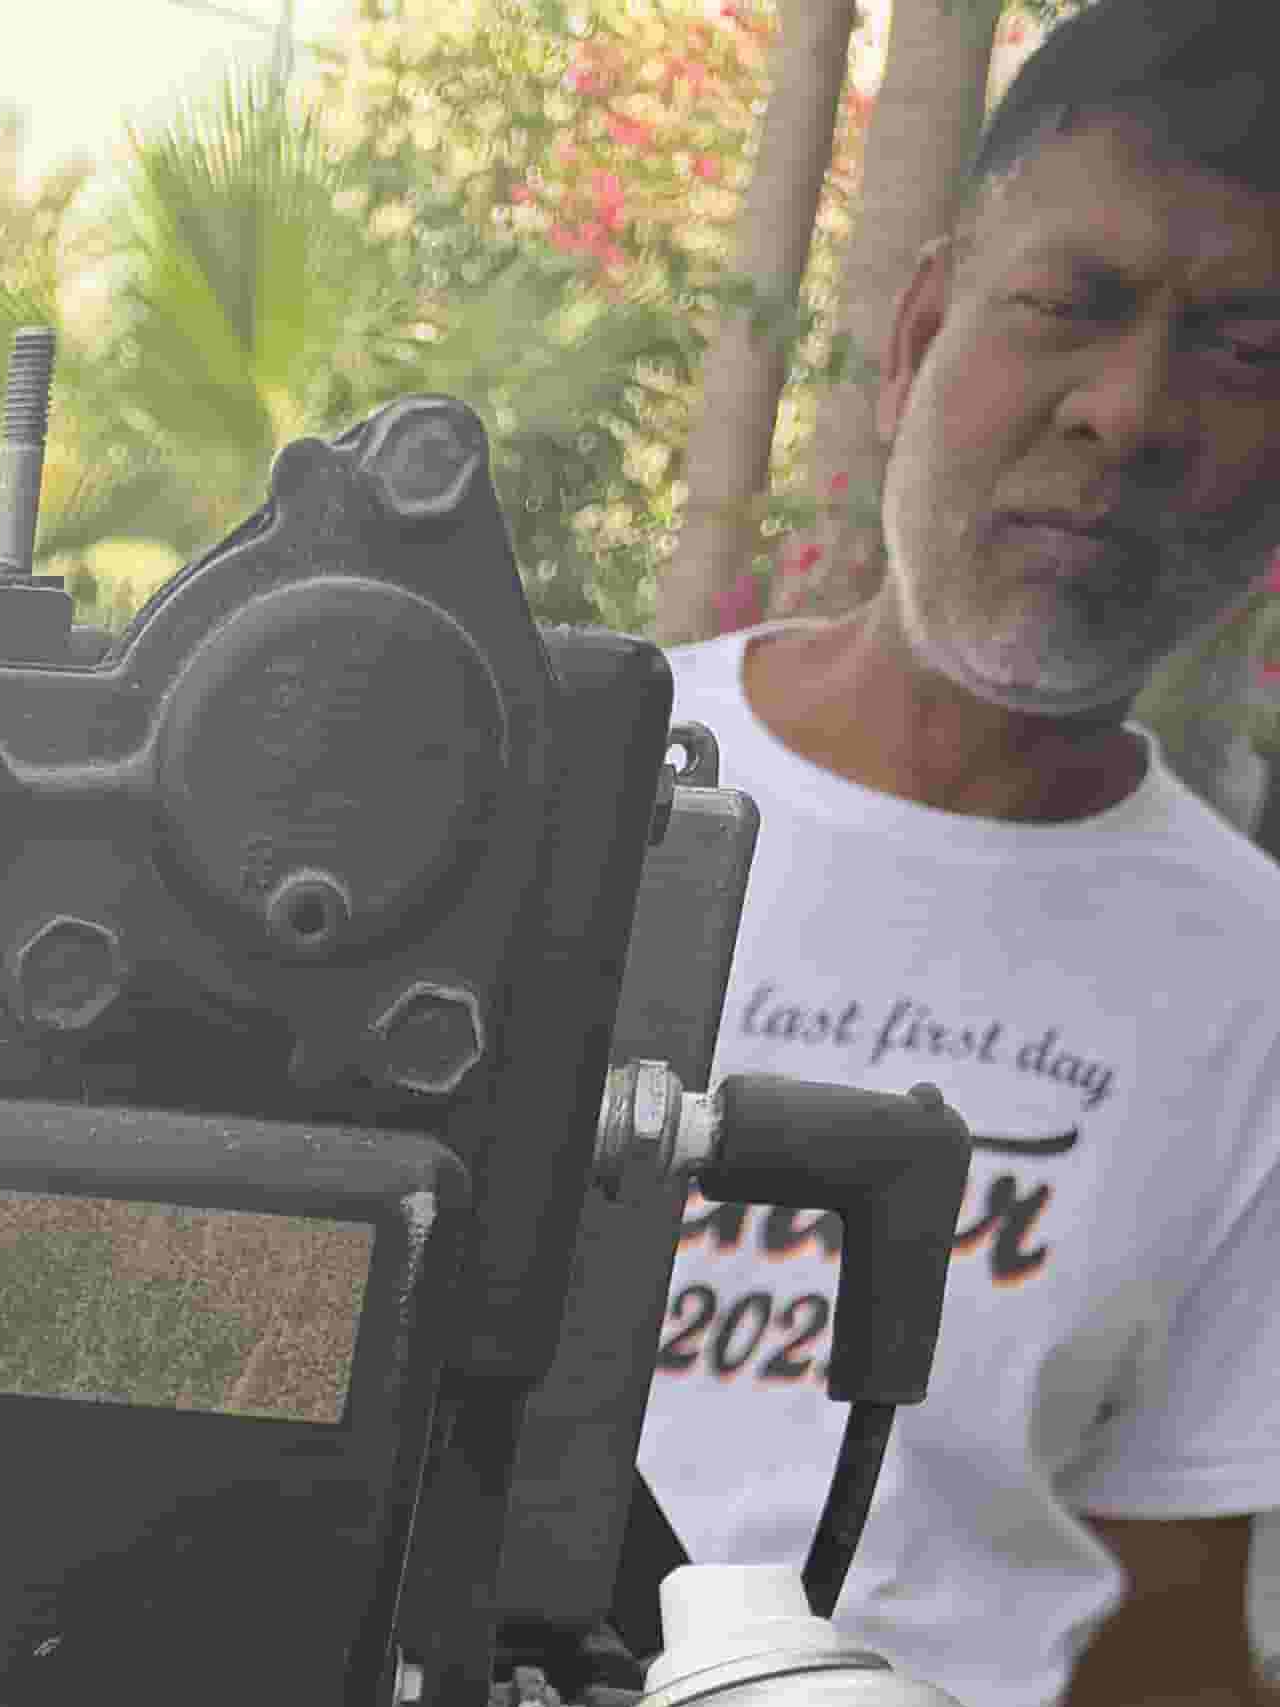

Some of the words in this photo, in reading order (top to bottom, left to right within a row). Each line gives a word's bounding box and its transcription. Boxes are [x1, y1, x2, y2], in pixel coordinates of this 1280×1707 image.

[744, 982, 863, 1040] last
[870, 997, 1005, 1067] first
[1015, 1028, 1115, 1110] day
[655, 1284, 833, 1380] 202
